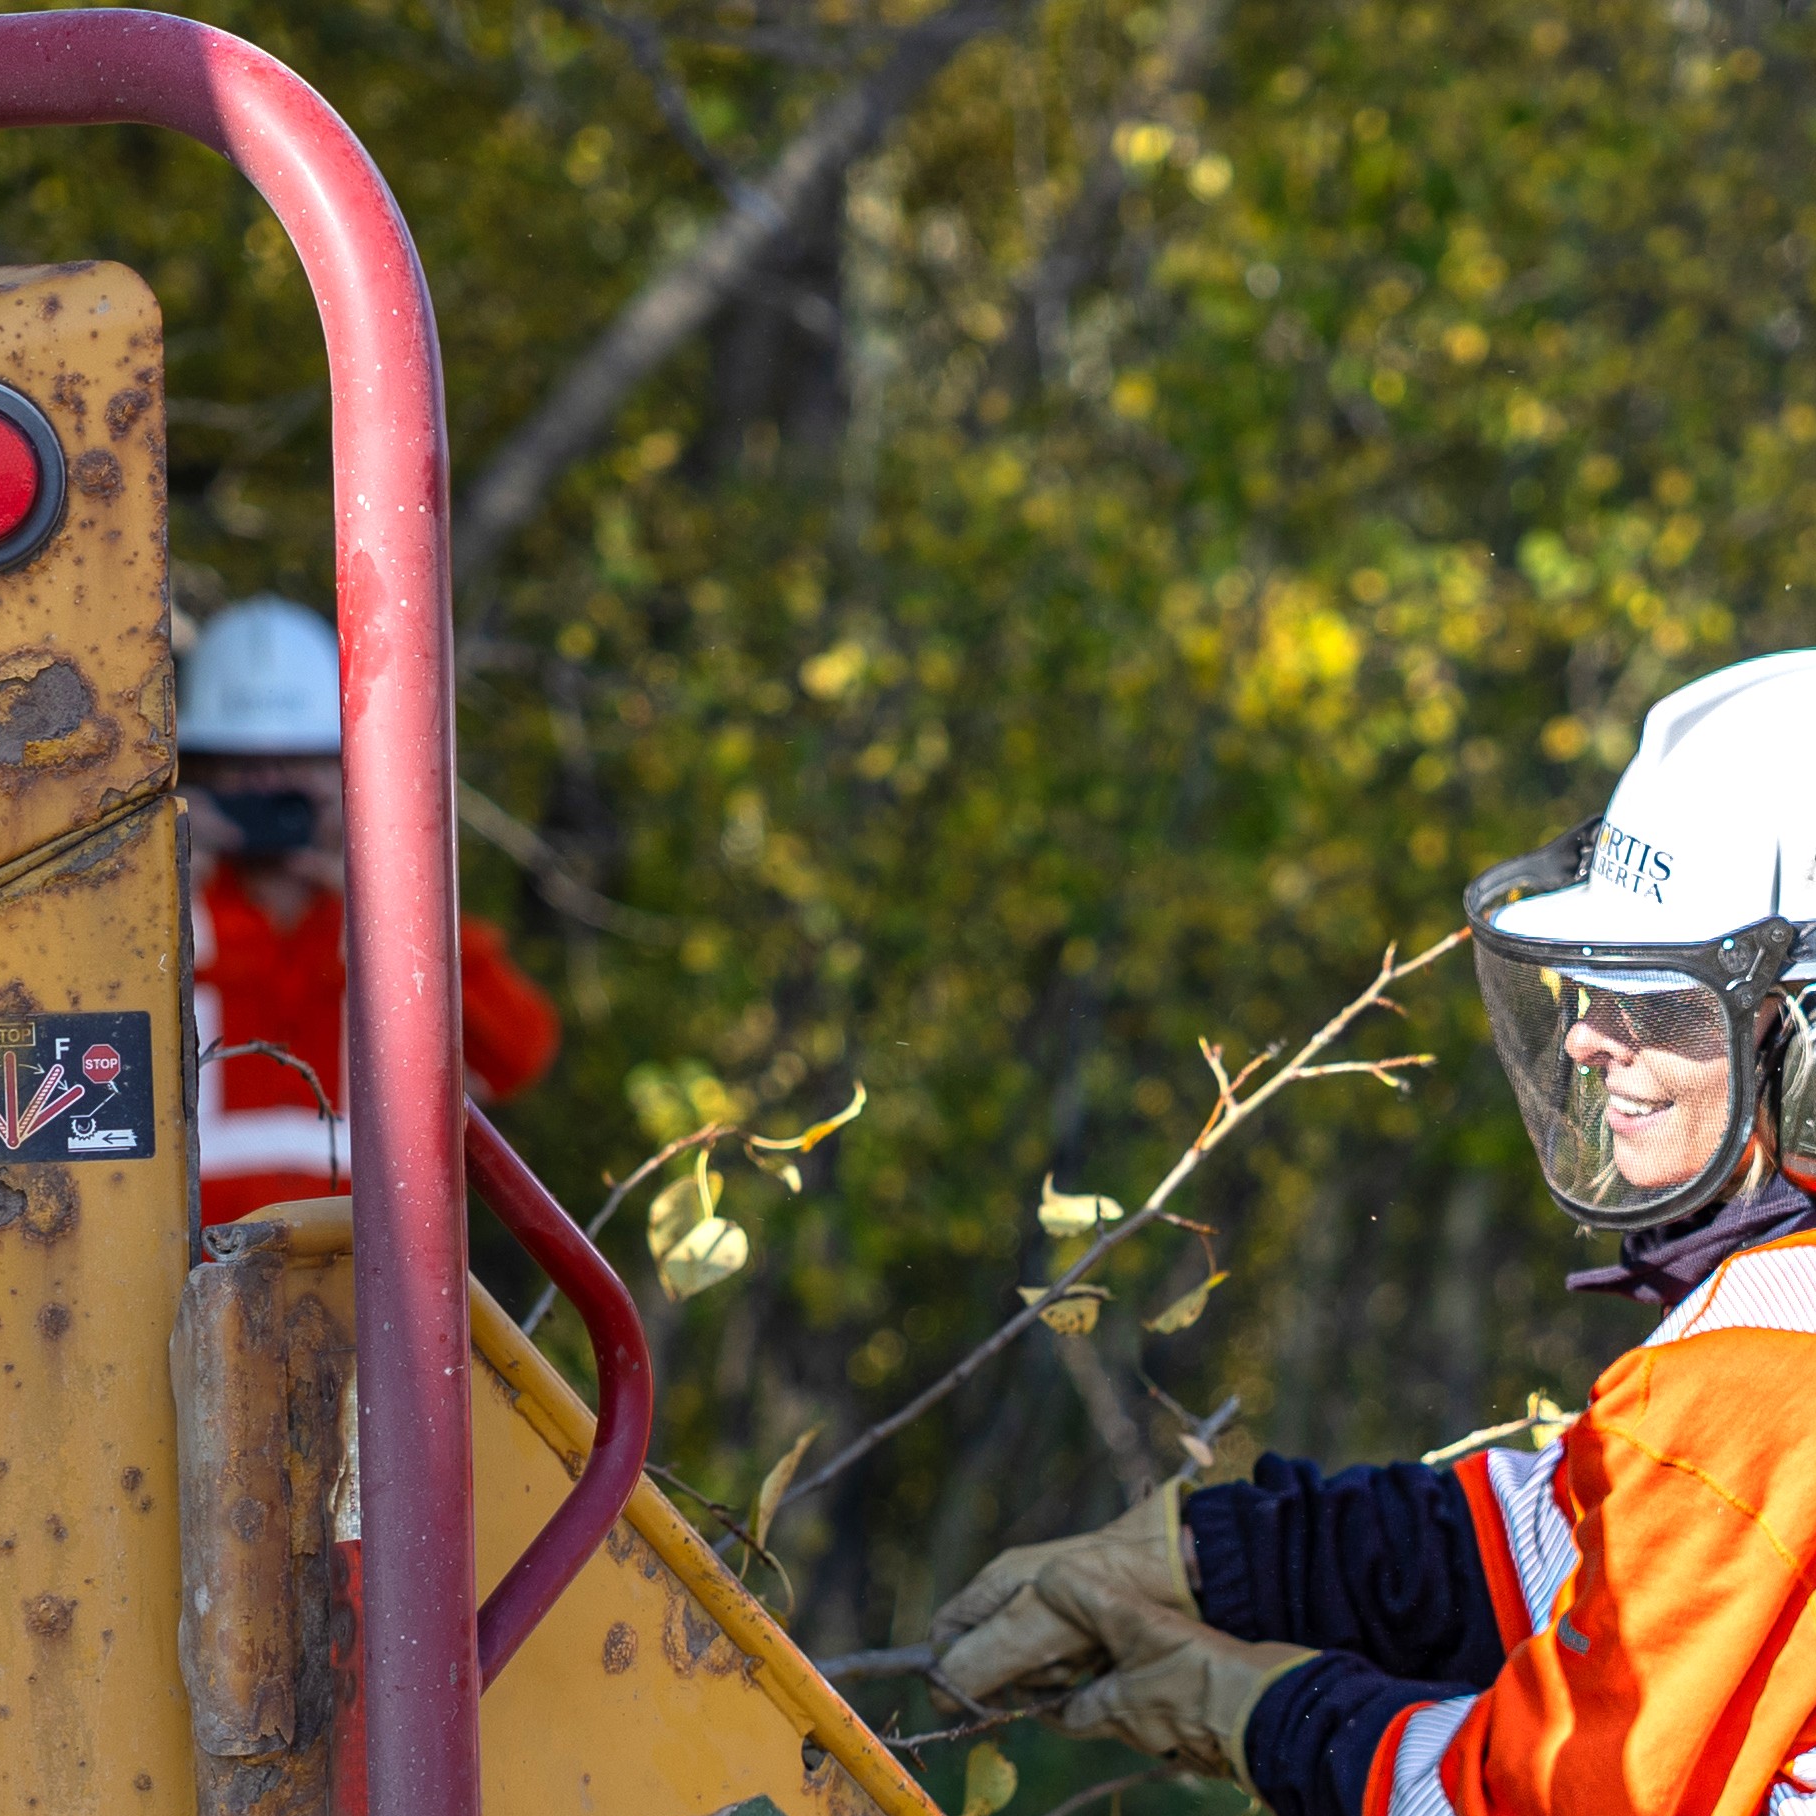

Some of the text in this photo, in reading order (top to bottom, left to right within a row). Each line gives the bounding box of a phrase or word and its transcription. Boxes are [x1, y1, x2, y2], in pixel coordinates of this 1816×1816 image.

[1599, 822, 1673, 881] ORTIS
[55, 1037, 70, 1060] F
[85, 1058, 118, 1070] STOP
